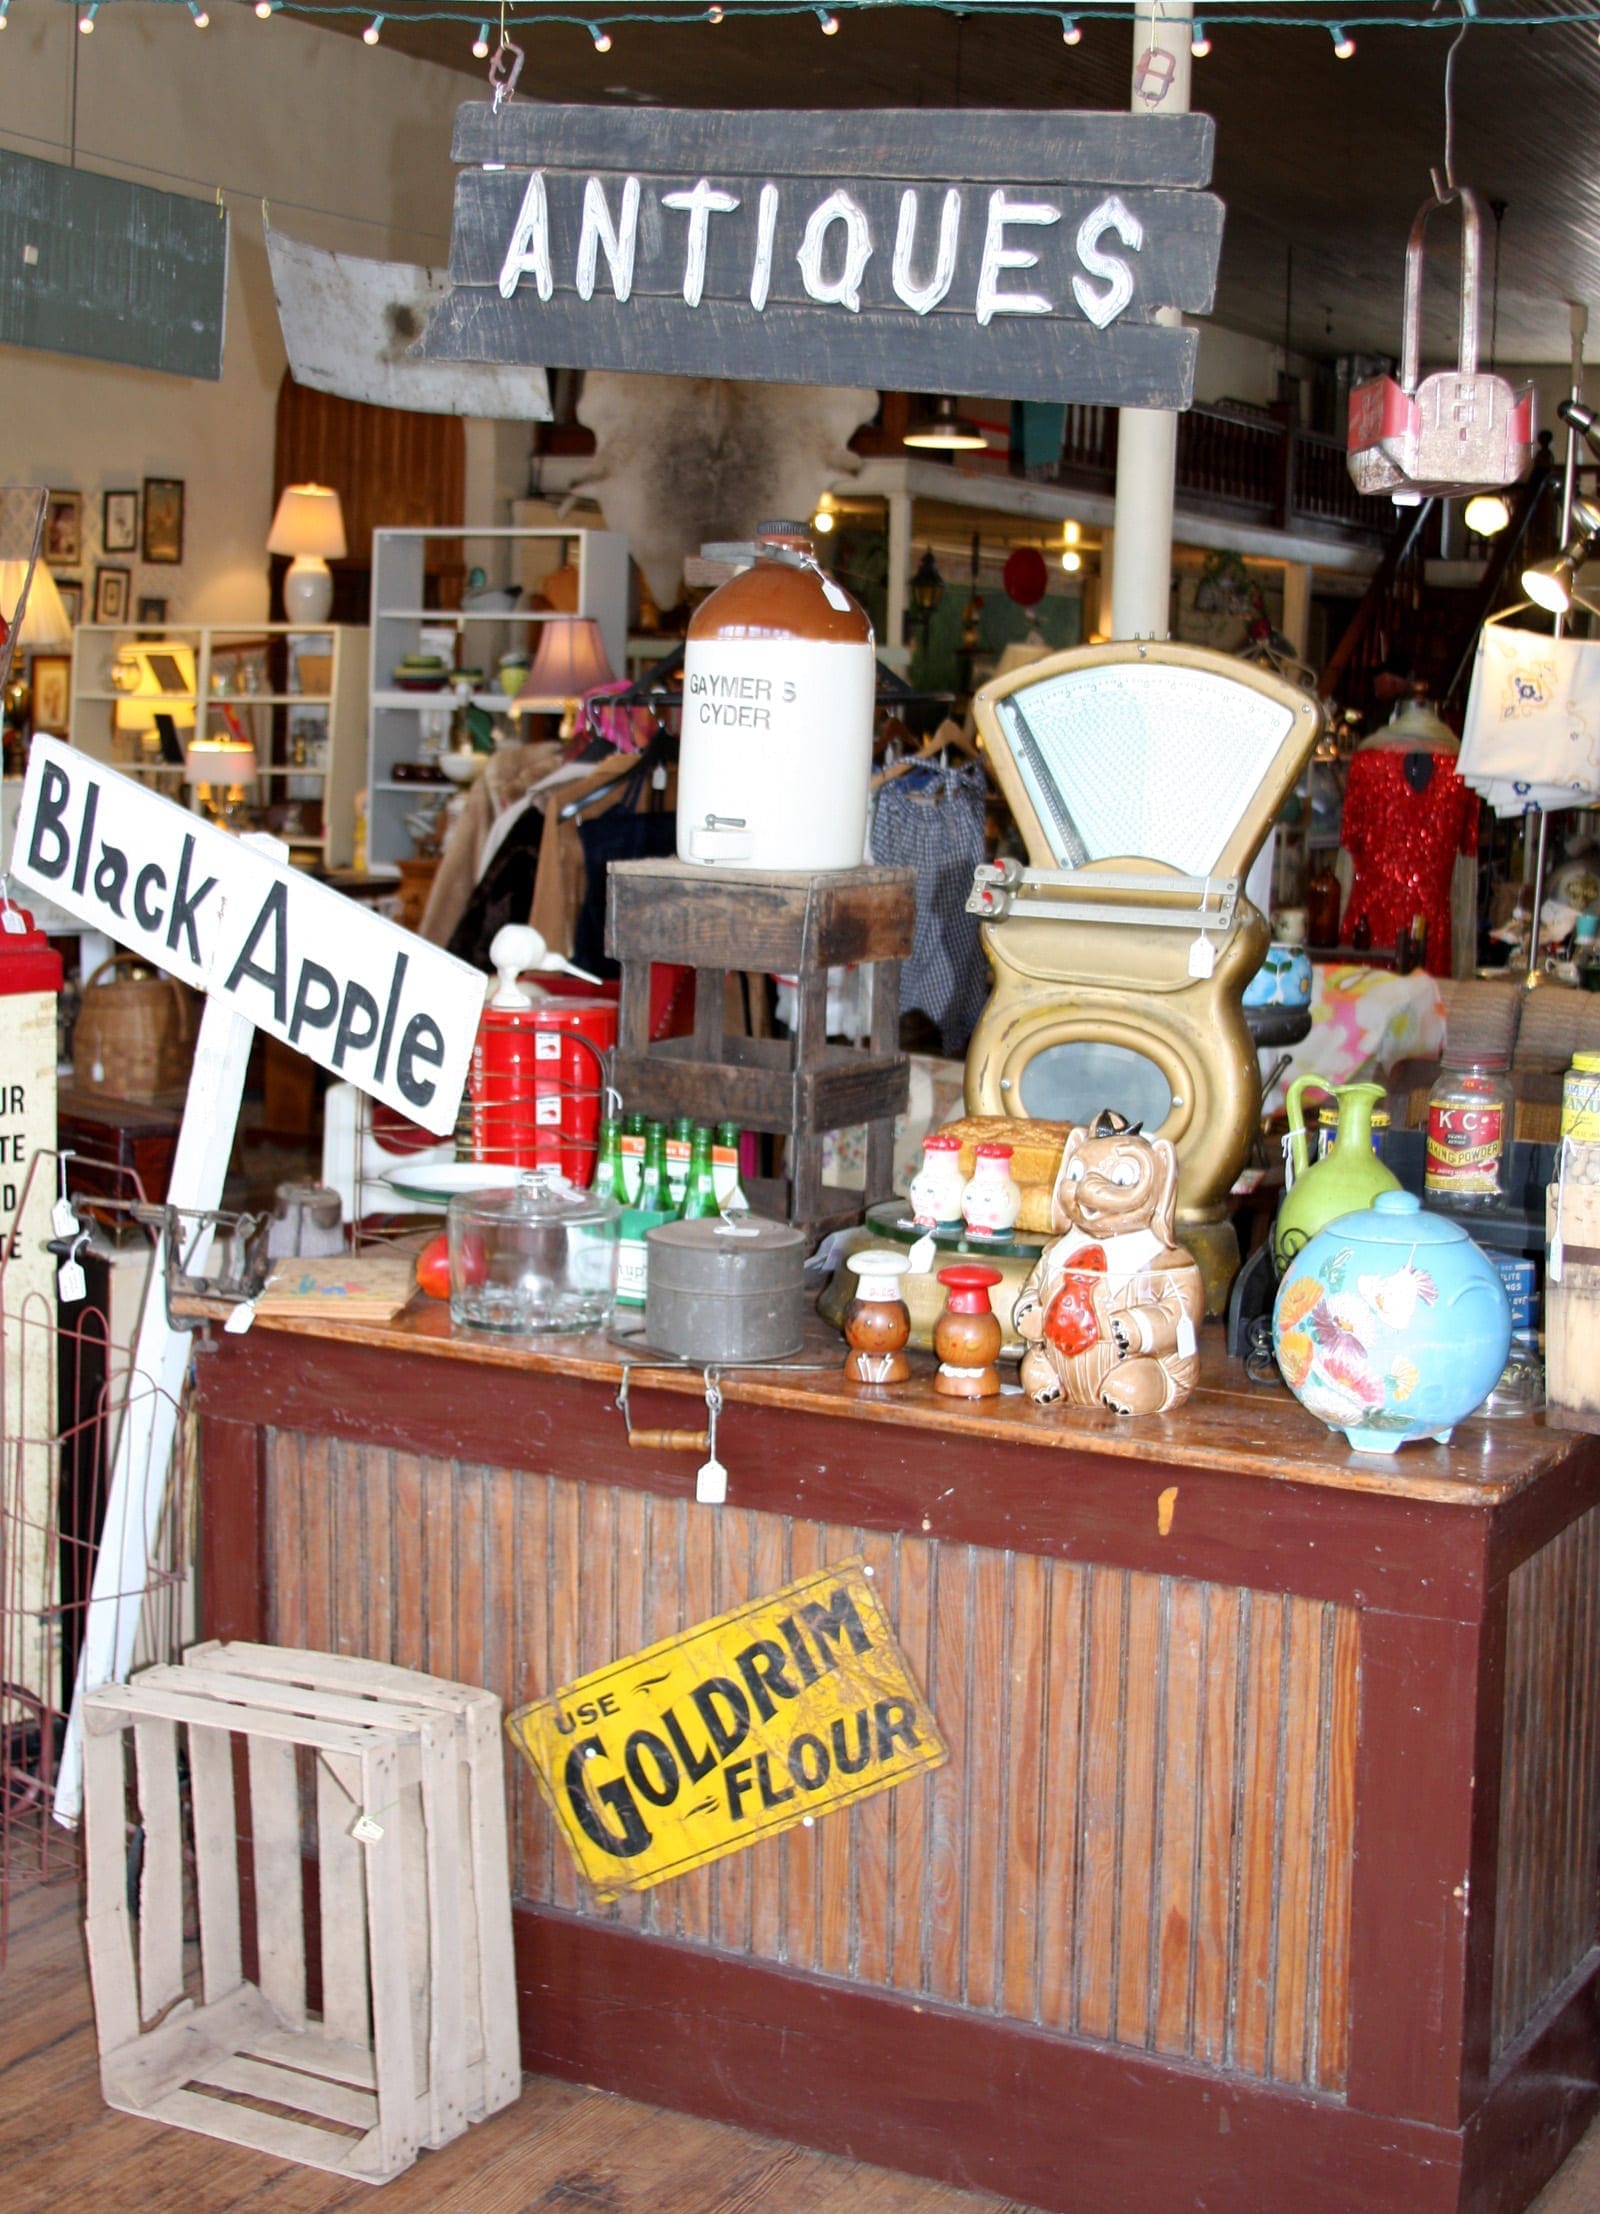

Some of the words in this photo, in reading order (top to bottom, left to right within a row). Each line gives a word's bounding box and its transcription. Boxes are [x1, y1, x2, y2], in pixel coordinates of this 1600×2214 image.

[499, 170, 1143, 329] ANTIQUES
[690, 673, 773, 701] GAYMER
[699, 702, 772, 730] CYDER
[27, 759, 218, 968] Black
[224, 880, 445, 1108] Apple
[1428, 1139, 1457, 1163] AKING
[1458, 1143, 1498, 1164] POWDER
[554, 1692, 621, 1735] USE
[565, 1587, 874, 1858] GOLDRIM
[723, 1696, 922, 1822] FLOUR
